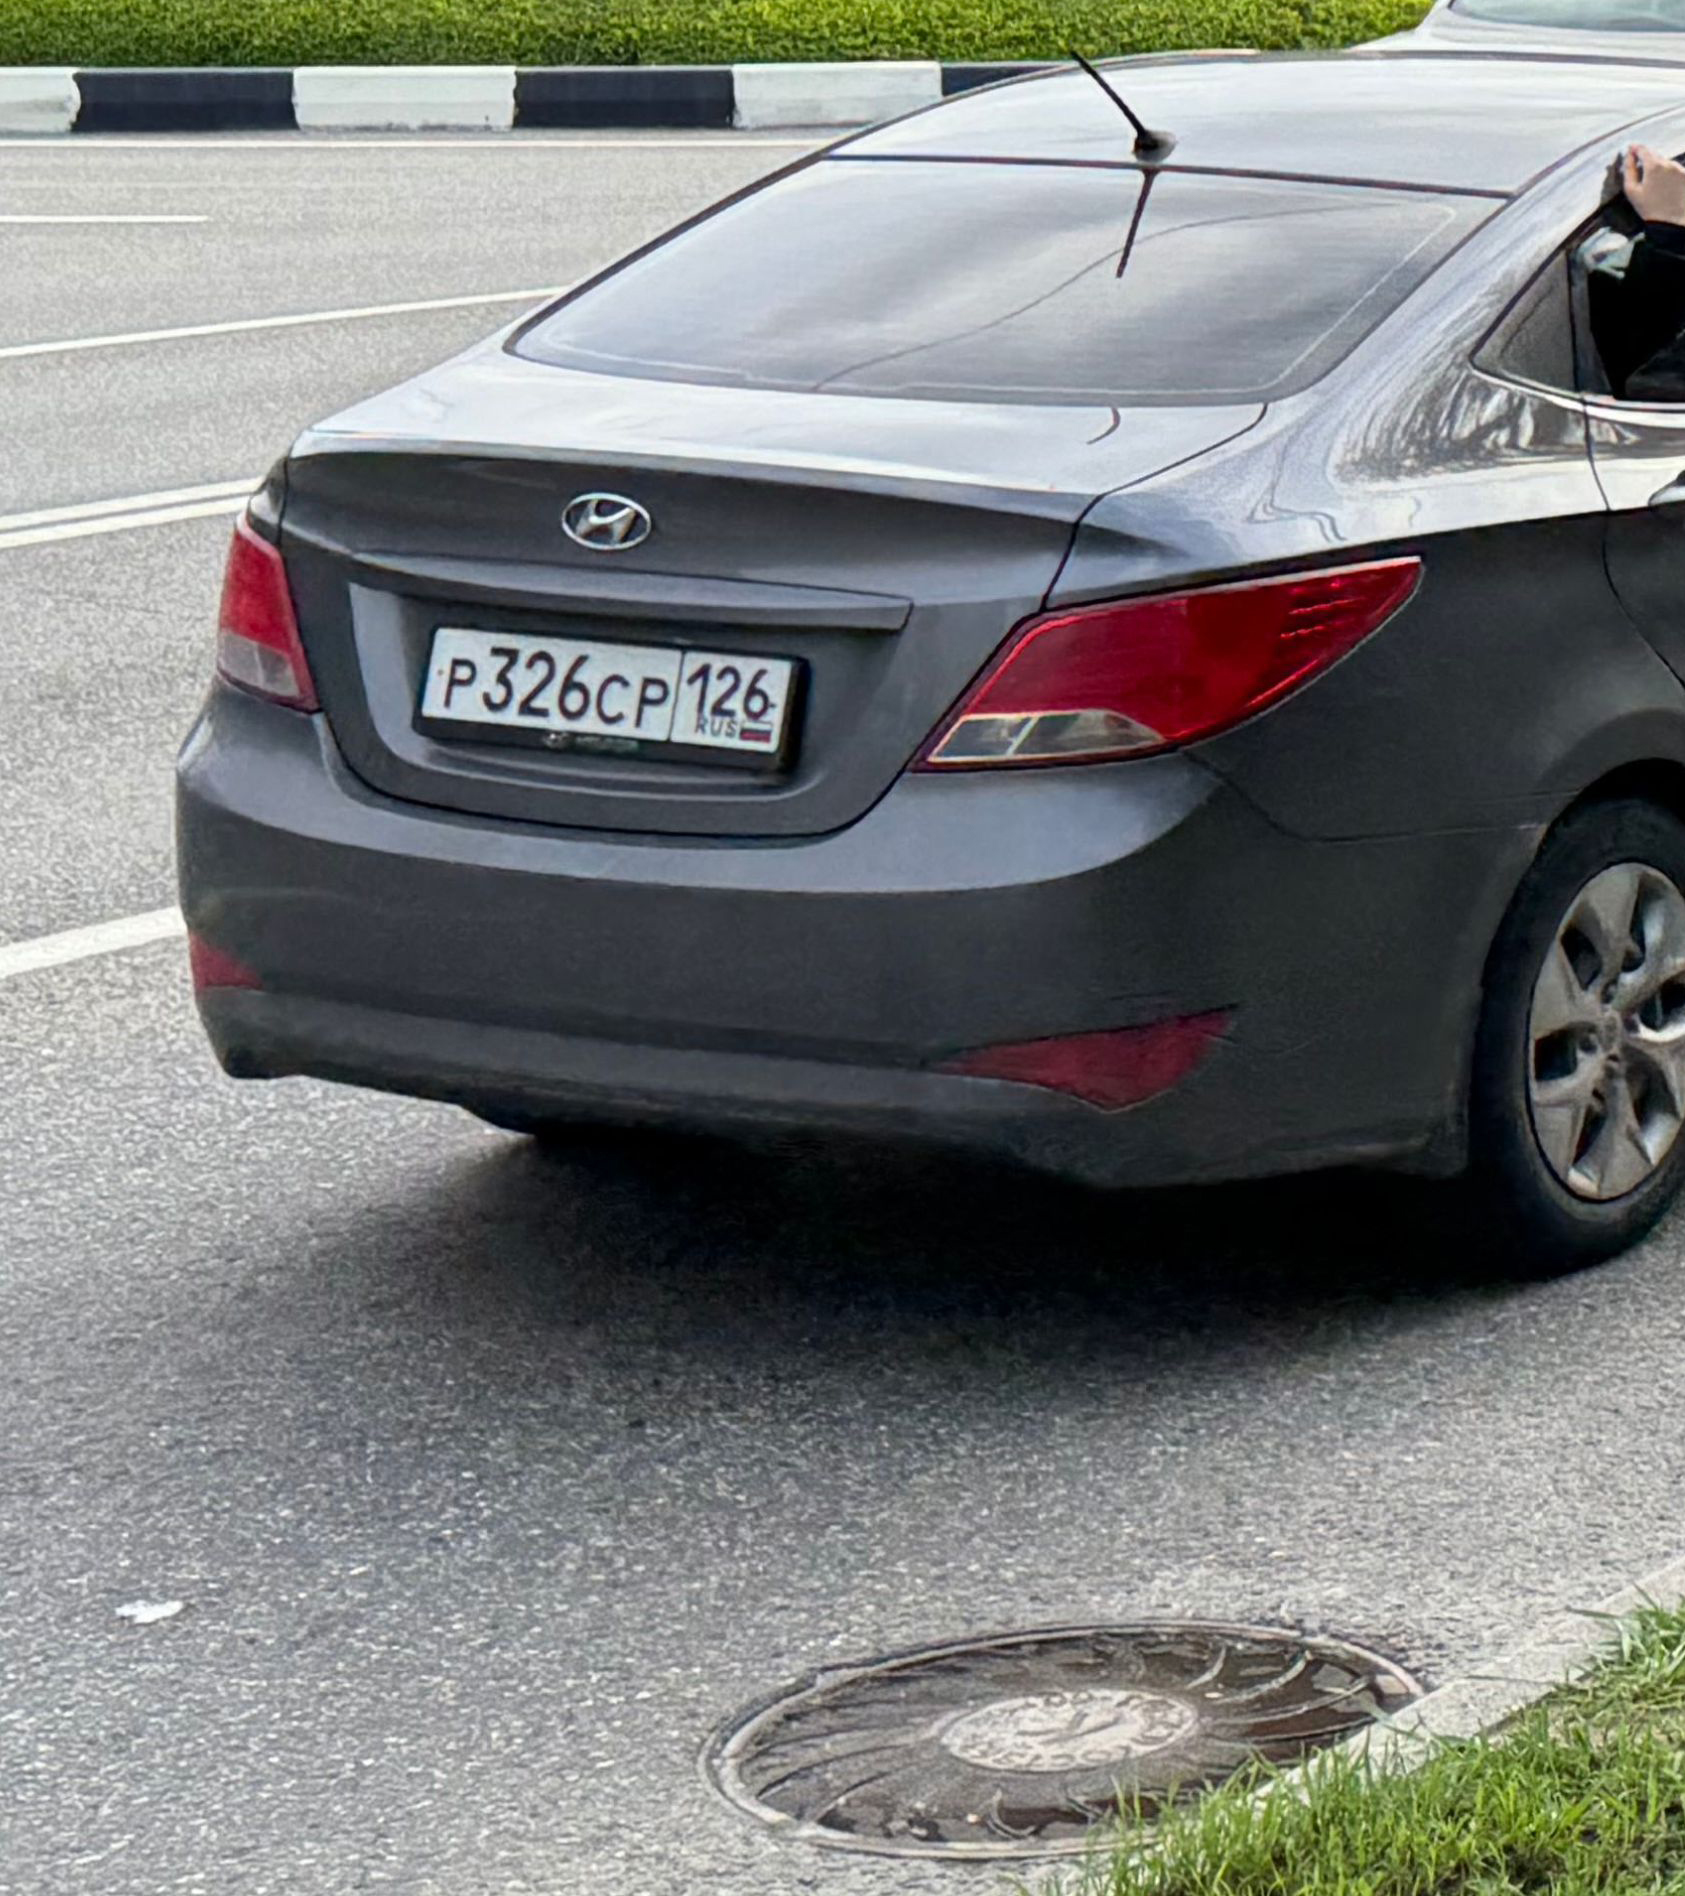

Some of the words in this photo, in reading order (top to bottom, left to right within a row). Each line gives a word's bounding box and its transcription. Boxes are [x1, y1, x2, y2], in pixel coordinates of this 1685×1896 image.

[444, 646, 670, 729] Р326СР
[686, 663, 771, 721] 126
[694, 716, 738, 739] RUS
